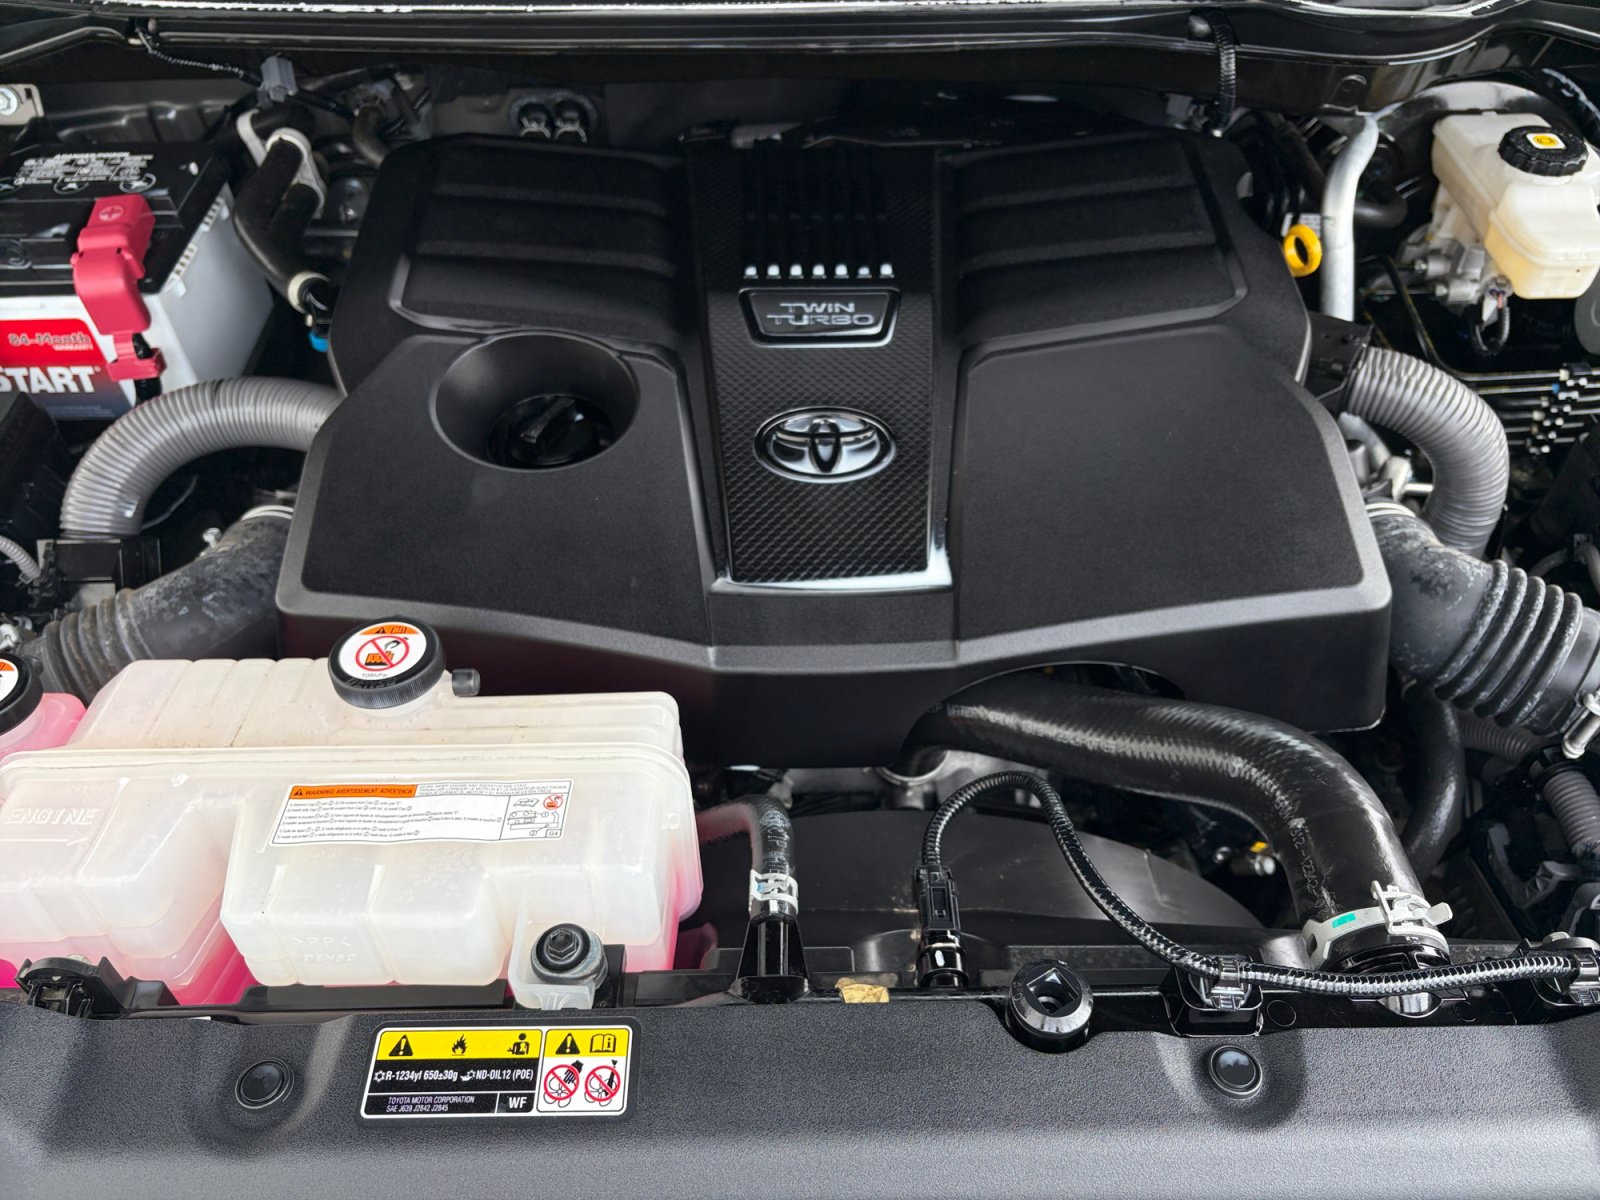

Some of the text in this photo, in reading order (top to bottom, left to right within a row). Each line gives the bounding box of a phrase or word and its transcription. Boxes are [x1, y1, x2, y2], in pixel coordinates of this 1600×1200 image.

[780, 303, 855, 313] TWIN
[766, 314, 875, 325] TURBO
[305, 788, 334, 796] WARNING
[335, 787, 379, 795] AVERTISSEMENT
[3, 807, 98, 824] ENGINE
[386, 1070, 422, 1082] R-1234yf
[423, 1069, 458, 1081] 650±30g
[512, 1068, 534, 1081] (POE)
[388, 1095, 475, 1104] TOYOTA MOTOR CORPORATION
[508, 1097, 527, 1108] WF
[431, 1104, 449, 1112] J2845
